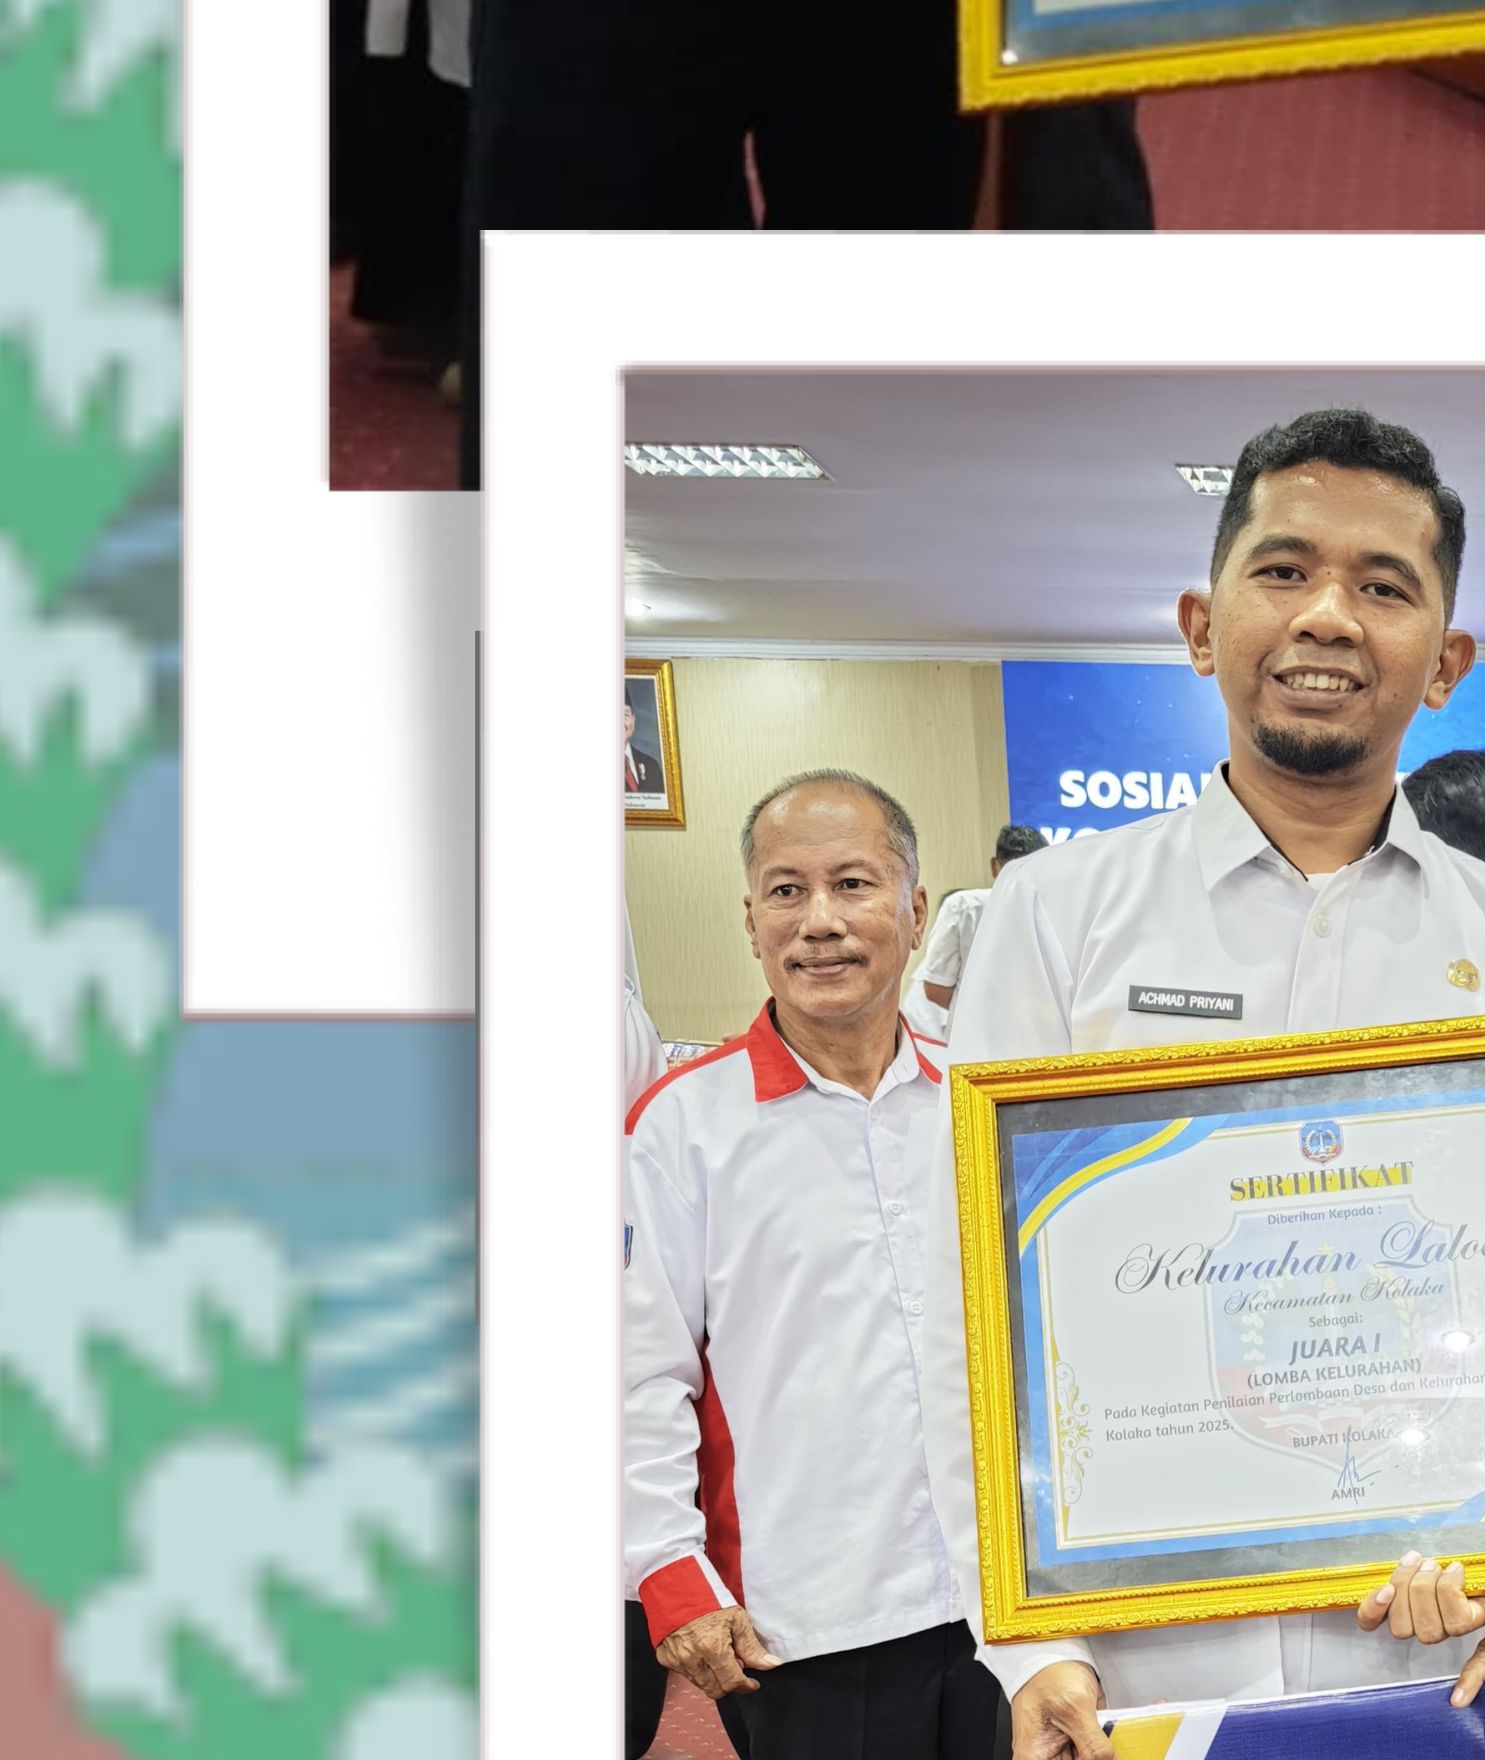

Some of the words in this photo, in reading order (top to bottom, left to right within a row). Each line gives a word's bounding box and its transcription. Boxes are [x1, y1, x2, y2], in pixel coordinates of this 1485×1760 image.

[1059, 770, 1212, 809] SOSIA
[1138, 991, 1185, 1008] ACHMAD
[1190, 995, 1234, 1011] PRIYANI
[1230, 1161, 1414, 1202] SERTIFIKAT
[1268, 1211, 1325, 1225] Diberikan
[1329, 1205, 1374, 1222] Kepada
[1115, 1240, 1361, 1294] Kelurahan
[1224, 1289, 1354, 1315] Kecamatan
[1360, 1276, 1445, 1302] Kolaka
[1309, 1312, 1363, 1328] Sebagai:
[1289, 1334, 1367, 1366] JUARA
[1248, 1369, 1311, 1390] (LOMBA
[1316, 1358, 1422, 1381] KELURAHAN)
[1105, 1407, 1137, 1420] Pada
[1141, 1402, 1199, 1419] Kegiatan
[1204, 1394, 1265, 1411] Penilaian
[1269, 1387, 1349, 1404] Perlombaan
[1354, 1381, 1386, 1396] Desa
[1390, 1379, 1415, 1393] dan
[1106, 1427, 1151, 1441] Kolaka
[1156, 1423, 1194, 1437] tahun
[1293, 1433, 1338, 1448] BUPATI
[1331, 1486, 1365, 1500] AMRI
